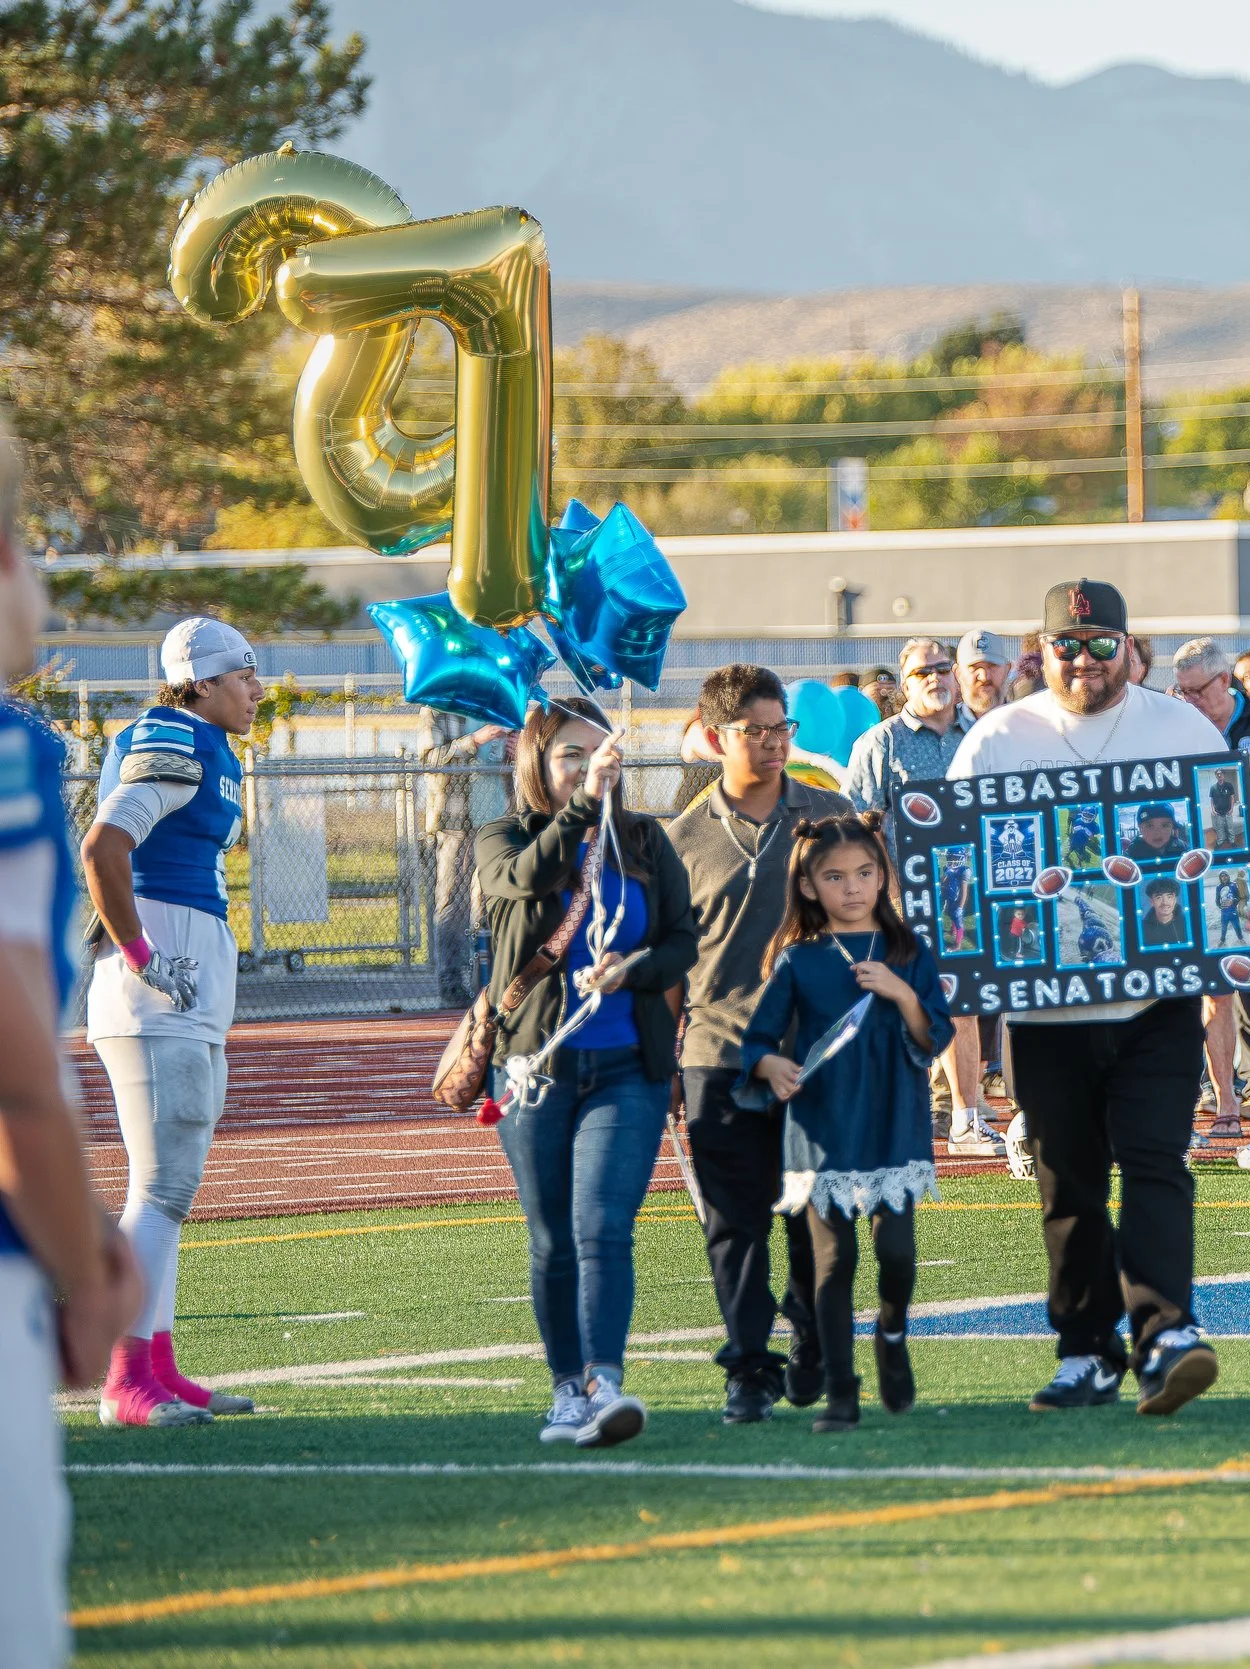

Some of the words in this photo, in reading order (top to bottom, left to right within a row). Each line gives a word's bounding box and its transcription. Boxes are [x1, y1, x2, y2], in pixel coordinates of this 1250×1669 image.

[953, 760, 1182, 807] SEBASTIAN
[995, 867, 1034, 882] 2027
[997, 859, 1021, 869] CLASS
[1021, 859, 1031, 867] OF
[980, 964, 1203, 1011] SENATORS
